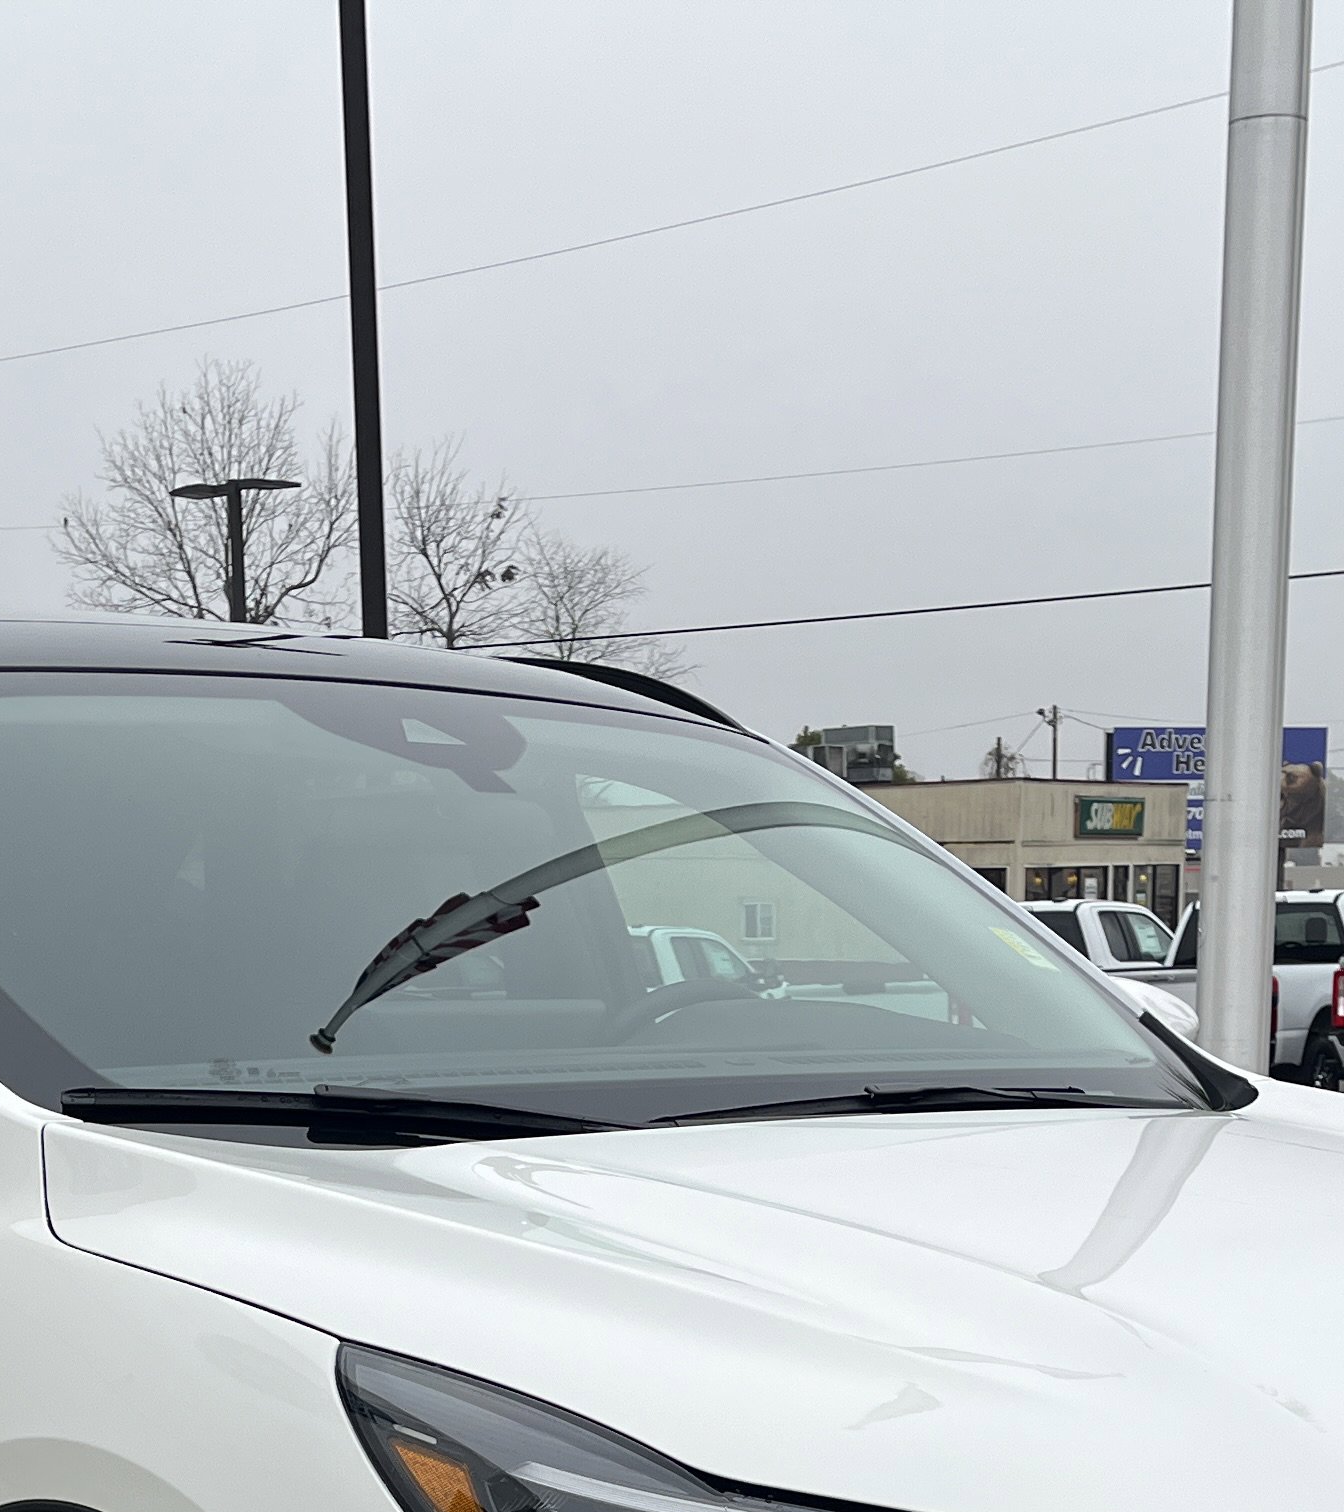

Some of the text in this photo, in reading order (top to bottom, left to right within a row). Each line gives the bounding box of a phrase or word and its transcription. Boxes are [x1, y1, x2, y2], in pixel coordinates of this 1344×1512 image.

[1139, 729, 1205, 752] Adve
[1173, 752, 1205, 774] He
[1086, 803, 1142, 830] SUBWAY
[1279, 828, 1306, 839] .com
